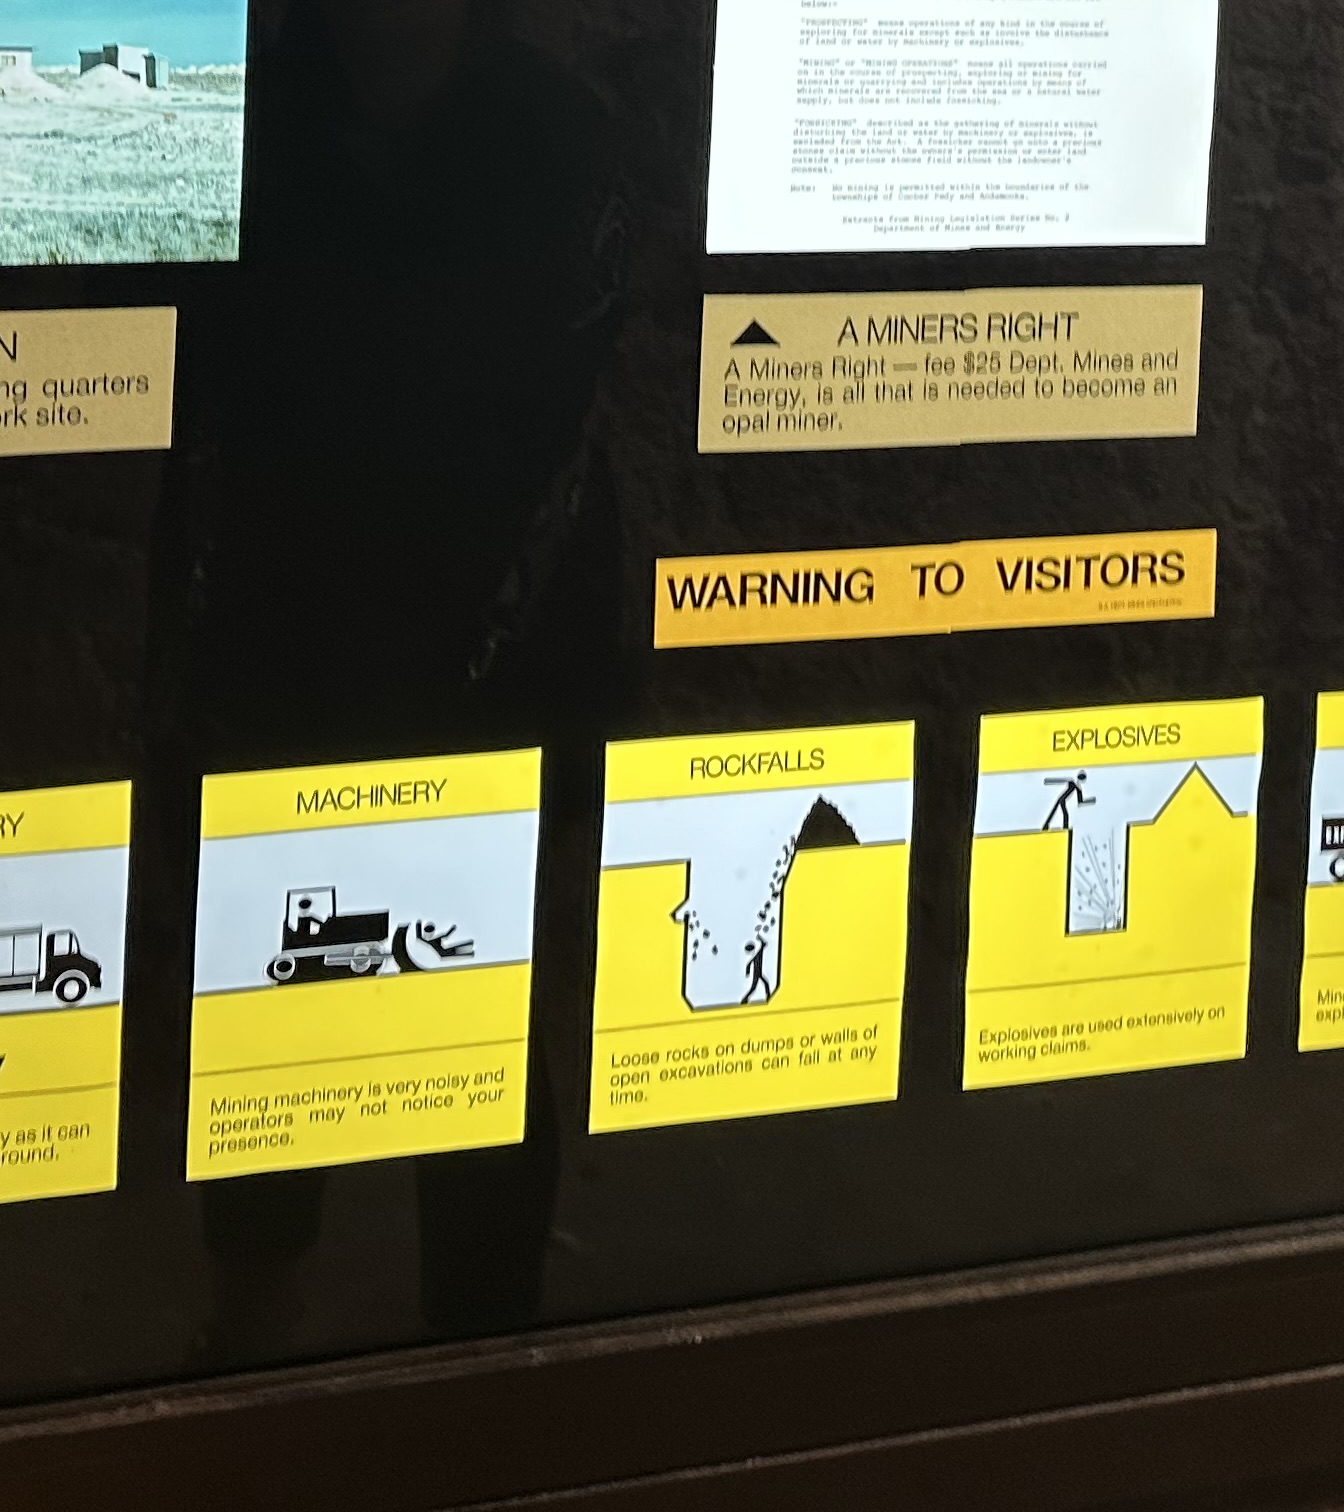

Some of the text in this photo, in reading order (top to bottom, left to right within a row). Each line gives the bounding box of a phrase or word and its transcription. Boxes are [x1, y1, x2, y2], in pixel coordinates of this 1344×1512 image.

[837, 309, 1079, 347] A MINERS RIGHT
[723, 345, 1178, 384] A Miners Right fee $25 Dept. Mines and
[42, 371, 149, 404] quarters
[724, 375, 1177, 411] Energy, is all that is needed to become an
[35, 402, 88, 428] site.
[666, 550, 1185, 612] WARNING TO VISITORS
[1052, 723, 1181, 752] EXPLOSIVES
[690, 748, 825, 779] ROCKFALLS
[296, 779, 447, 814] MACHINERY
[978, 1005, 1226, 1047] Explosives are used extensively on
[611, 1023, 878, 1069] Loose rocks on dumps or walls of
[978, 1037, 1091, 1062] working claims.
[210, 1066, 505, 1116] Mining machinery is very noisy and
[15, 1130, 37, 1146] as
[41, 1124, 53, 1144] it
[57, 1125, 90, 1142] can
